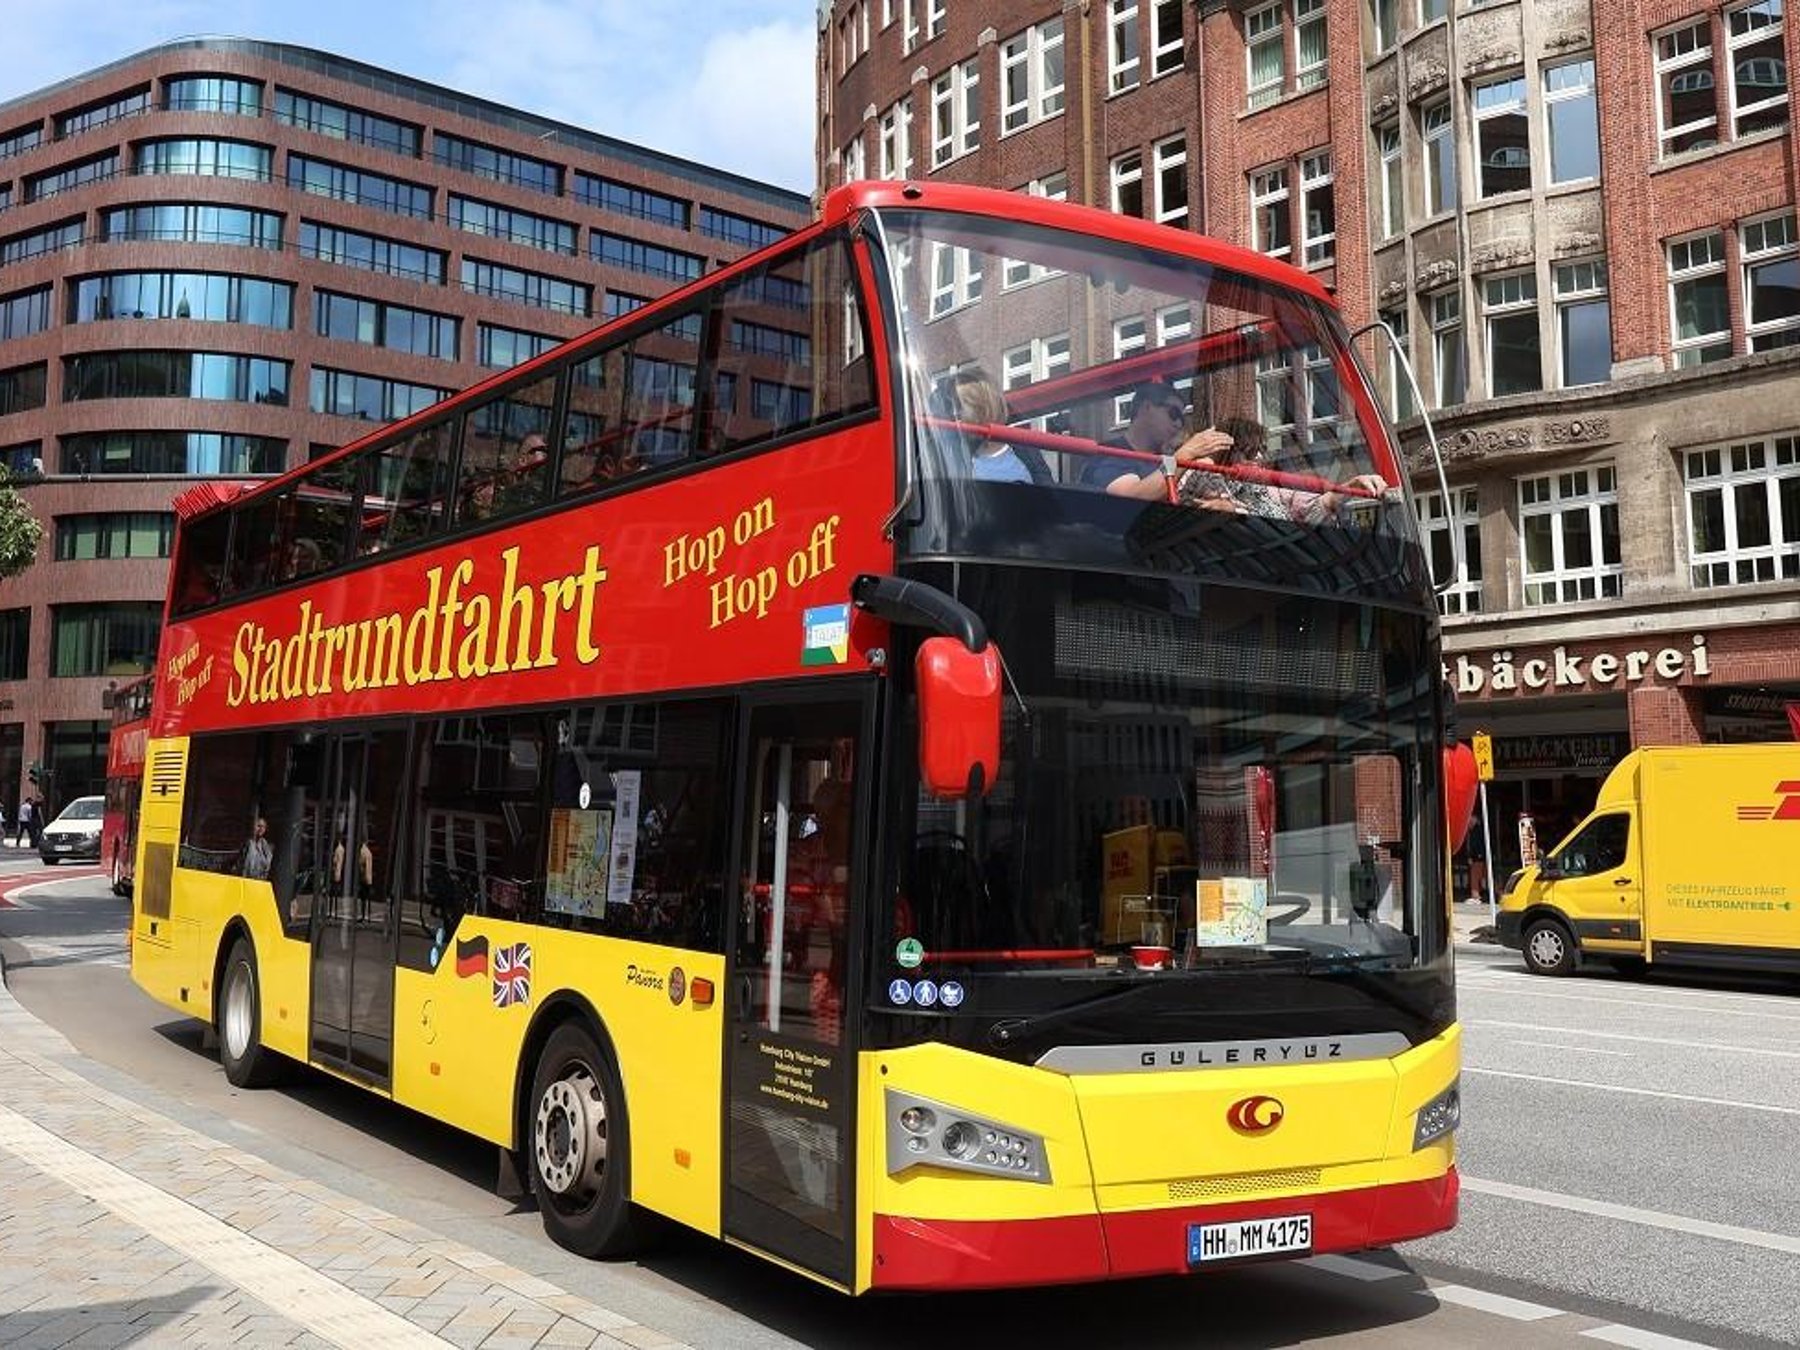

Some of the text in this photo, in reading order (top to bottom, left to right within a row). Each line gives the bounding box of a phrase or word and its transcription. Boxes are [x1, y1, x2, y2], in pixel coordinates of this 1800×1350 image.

[663, 497, 776, 588] Hop on
[709, 514, 841, 629] Hop off
[226, 545, 607, 708] Stadtrundfahrt
[1203, 1218, 1309, 1256] HH MM 4175
